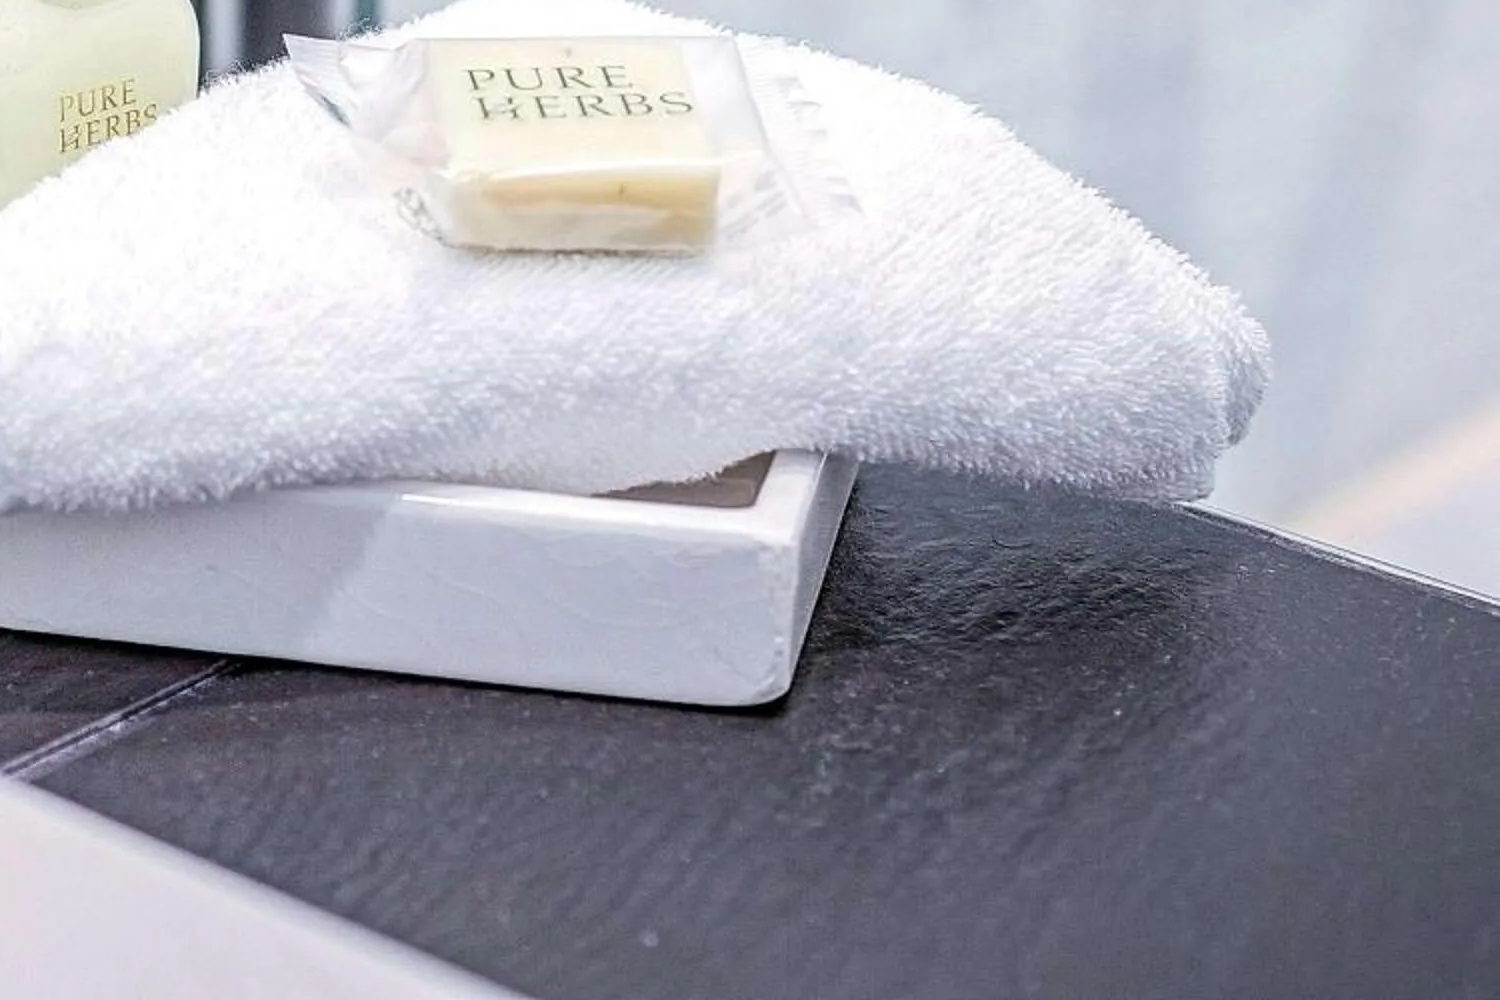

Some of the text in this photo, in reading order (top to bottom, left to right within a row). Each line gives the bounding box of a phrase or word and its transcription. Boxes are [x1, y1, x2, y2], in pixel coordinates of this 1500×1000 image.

[465, 65, 634, 91] PURE
[59, 78, 136, 122] PURE
[473, 92, 693, 121] HERBS
[60, 103, 158, 153] HERBS
